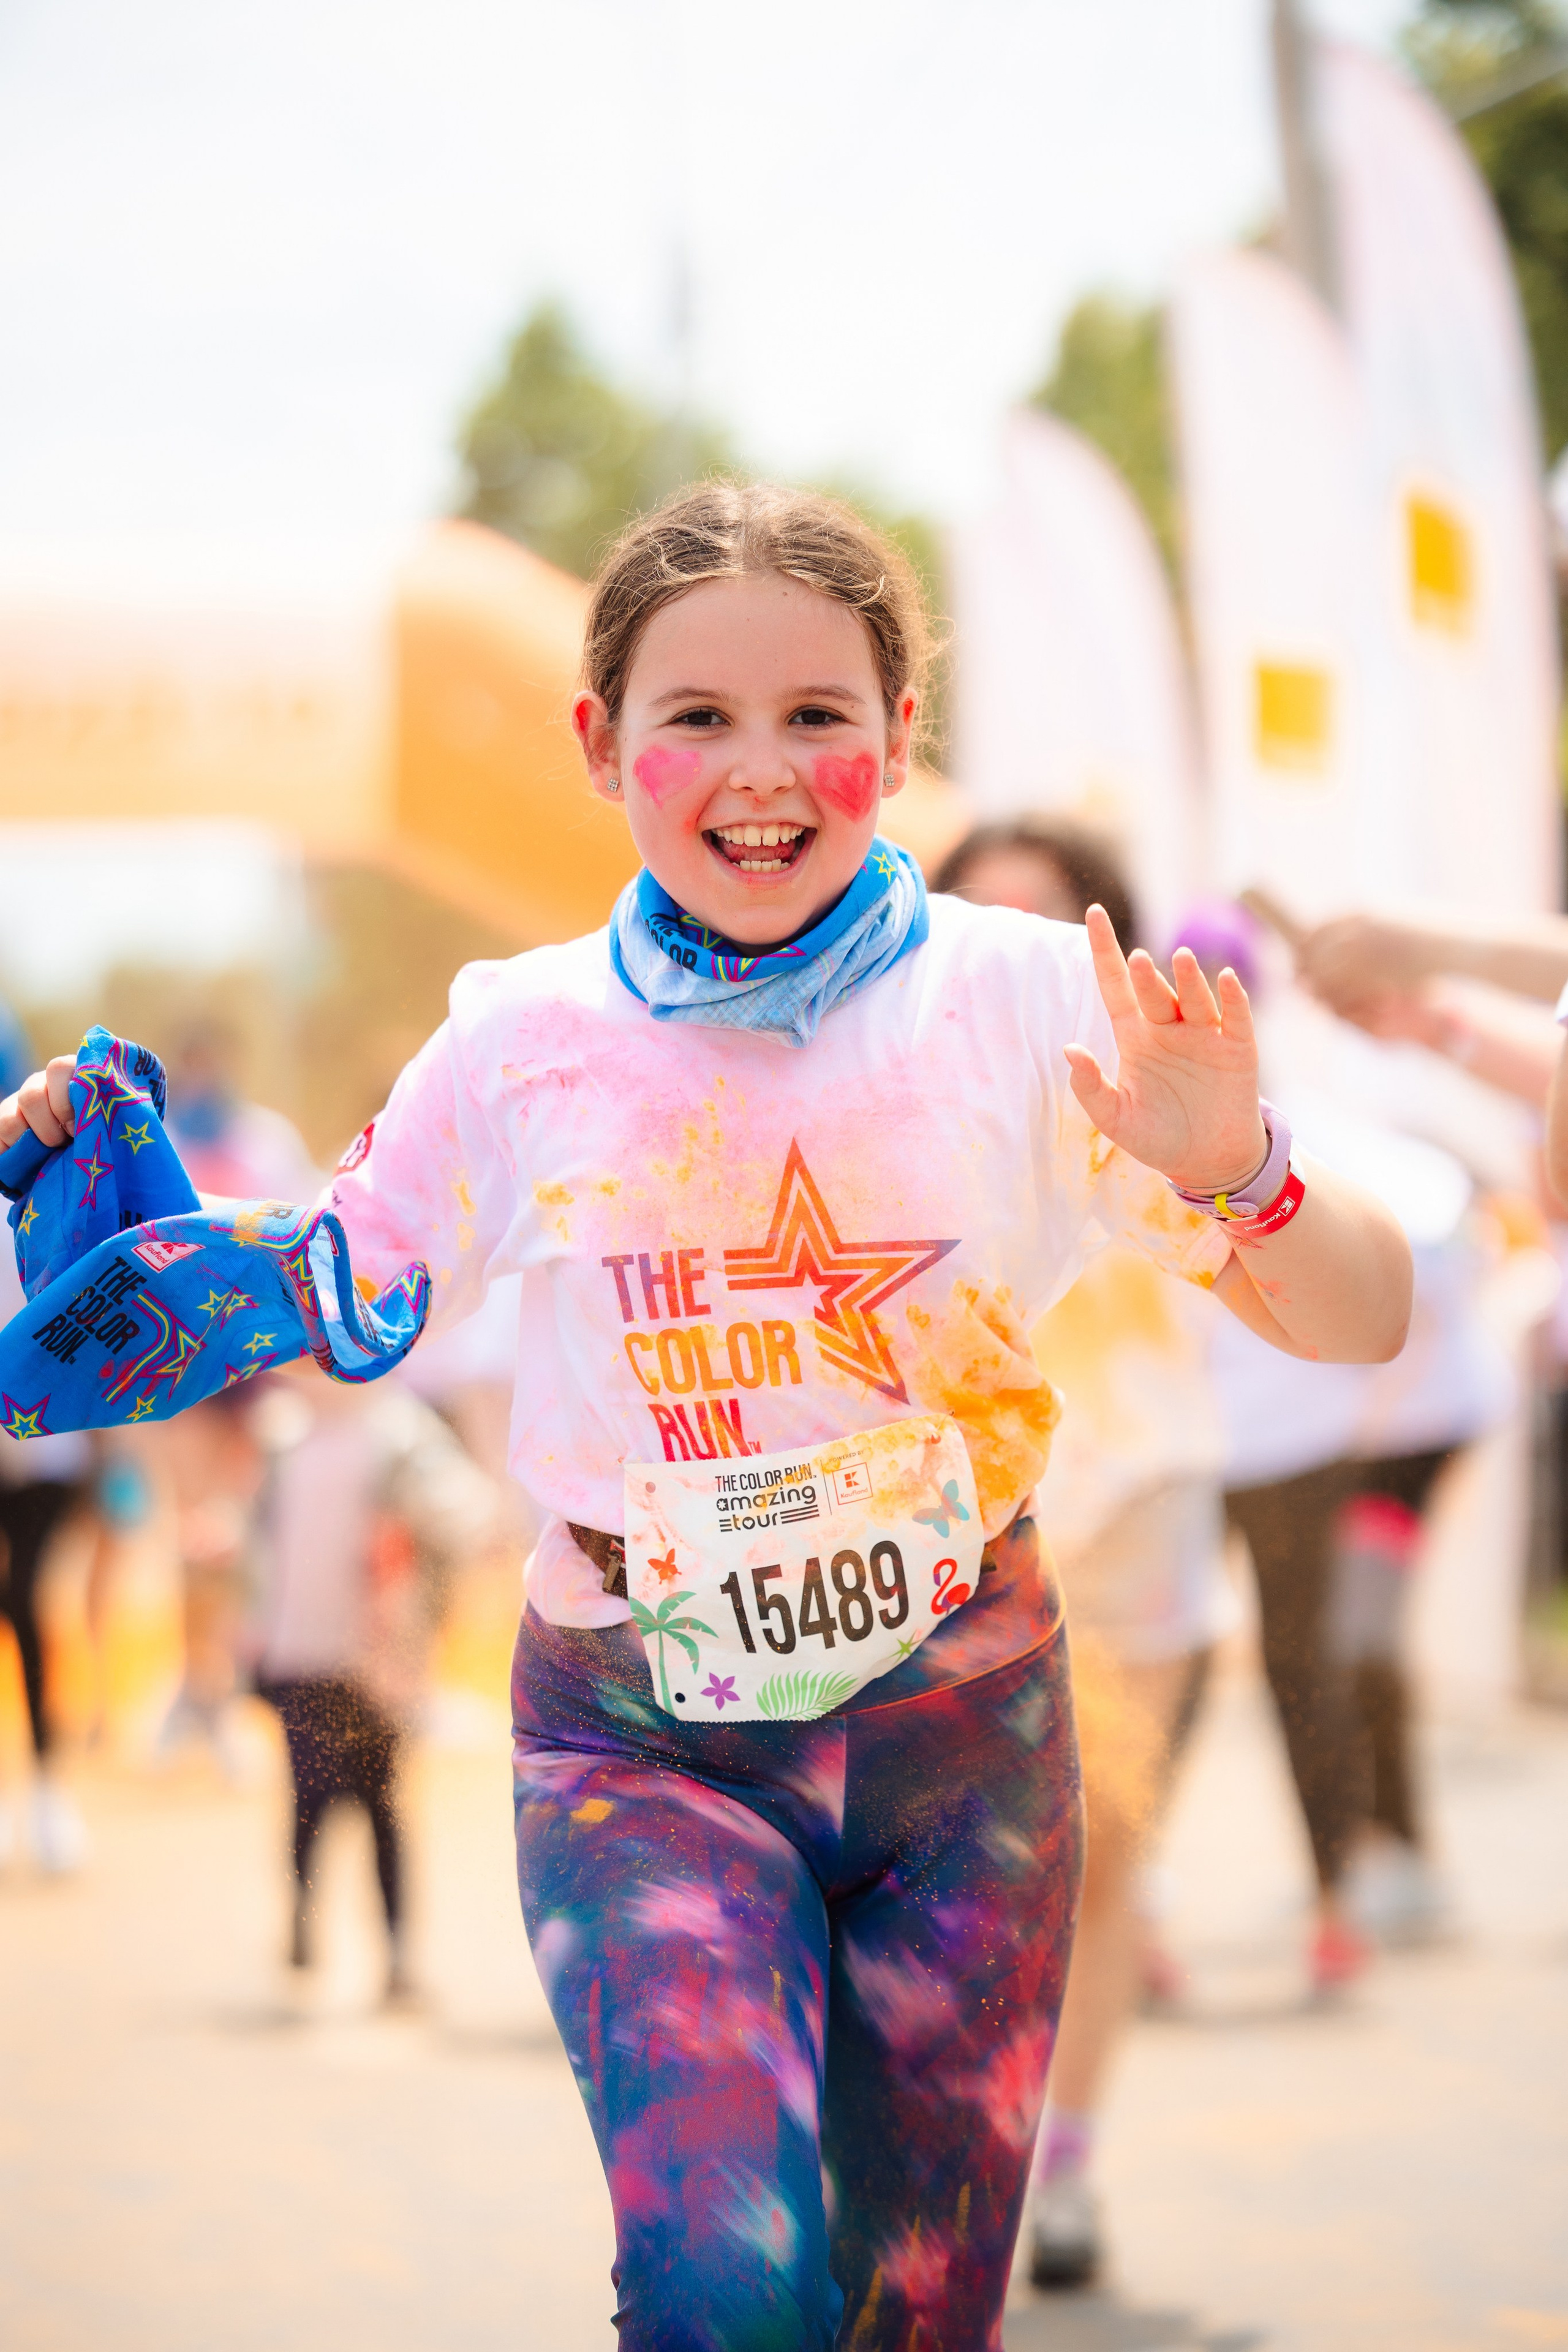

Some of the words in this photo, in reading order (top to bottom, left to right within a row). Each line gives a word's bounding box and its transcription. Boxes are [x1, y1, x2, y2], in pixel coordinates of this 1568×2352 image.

[1244, 1212, 1281, 1231] Kaufland
[145, 1243, 170, 1264] Kaufland
[94, 1256, 147, 1306] THE
[601, 1248, 711, 1323] THE
[66, 1286, 140, 1355] COLOR
[624, 1319, 803, 1396] COLOR
[829, 1452, 856, 1462] POWERED
[715, 1475, 738, 1492] THE
[739, 1469, 783, 1490] COLOR
[841, 1487, 869, 1498] Kaufland
[717, 1485, 816, 1511] amazing
[733, 1513, 778, 1531] tour
[719, 1540, 910, 1655] 15489
